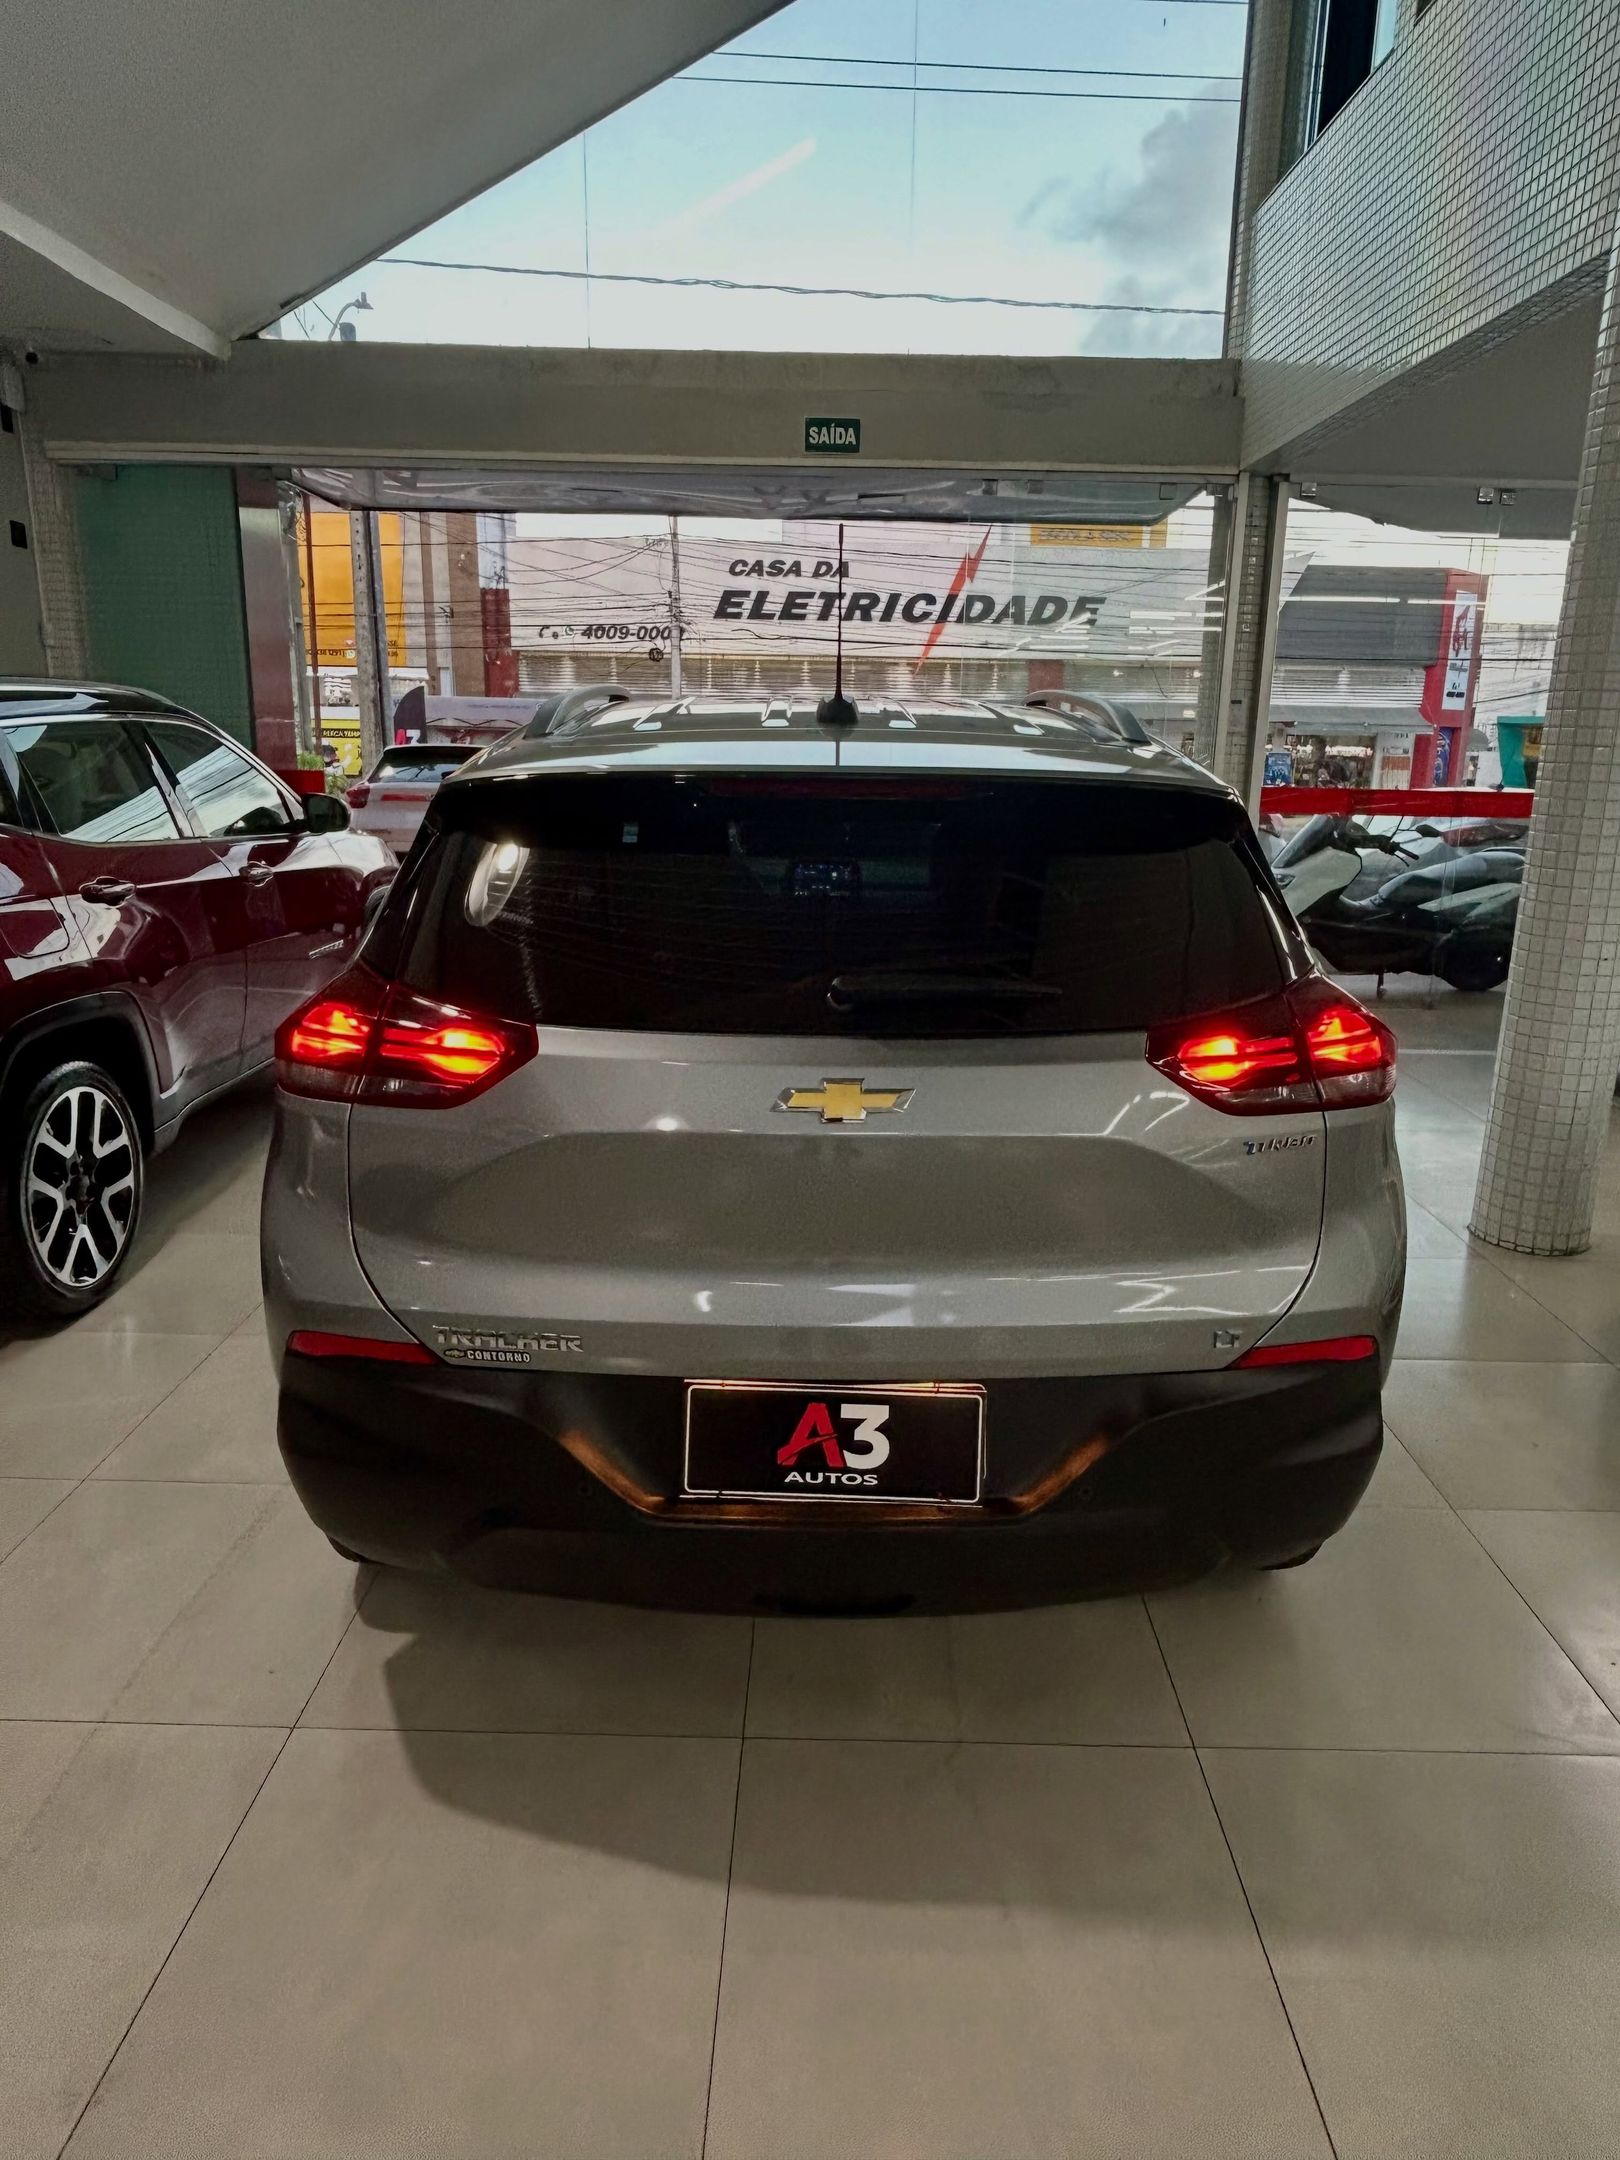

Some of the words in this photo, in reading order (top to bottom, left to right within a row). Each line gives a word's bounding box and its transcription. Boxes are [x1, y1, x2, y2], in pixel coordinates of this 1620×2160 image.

[808, 423, 857, 445] SAÍDA
[728, 559, 802, 577] CASA
[811, 561, 850, 578] DA
[713, 589, 1107, 627] ELETRICIDADE
[466, 1350, 531, 1363] CONTORNO
[777, 1402, 891, 1469] A3
[784, 1471, 879, 1486] AUTOS
